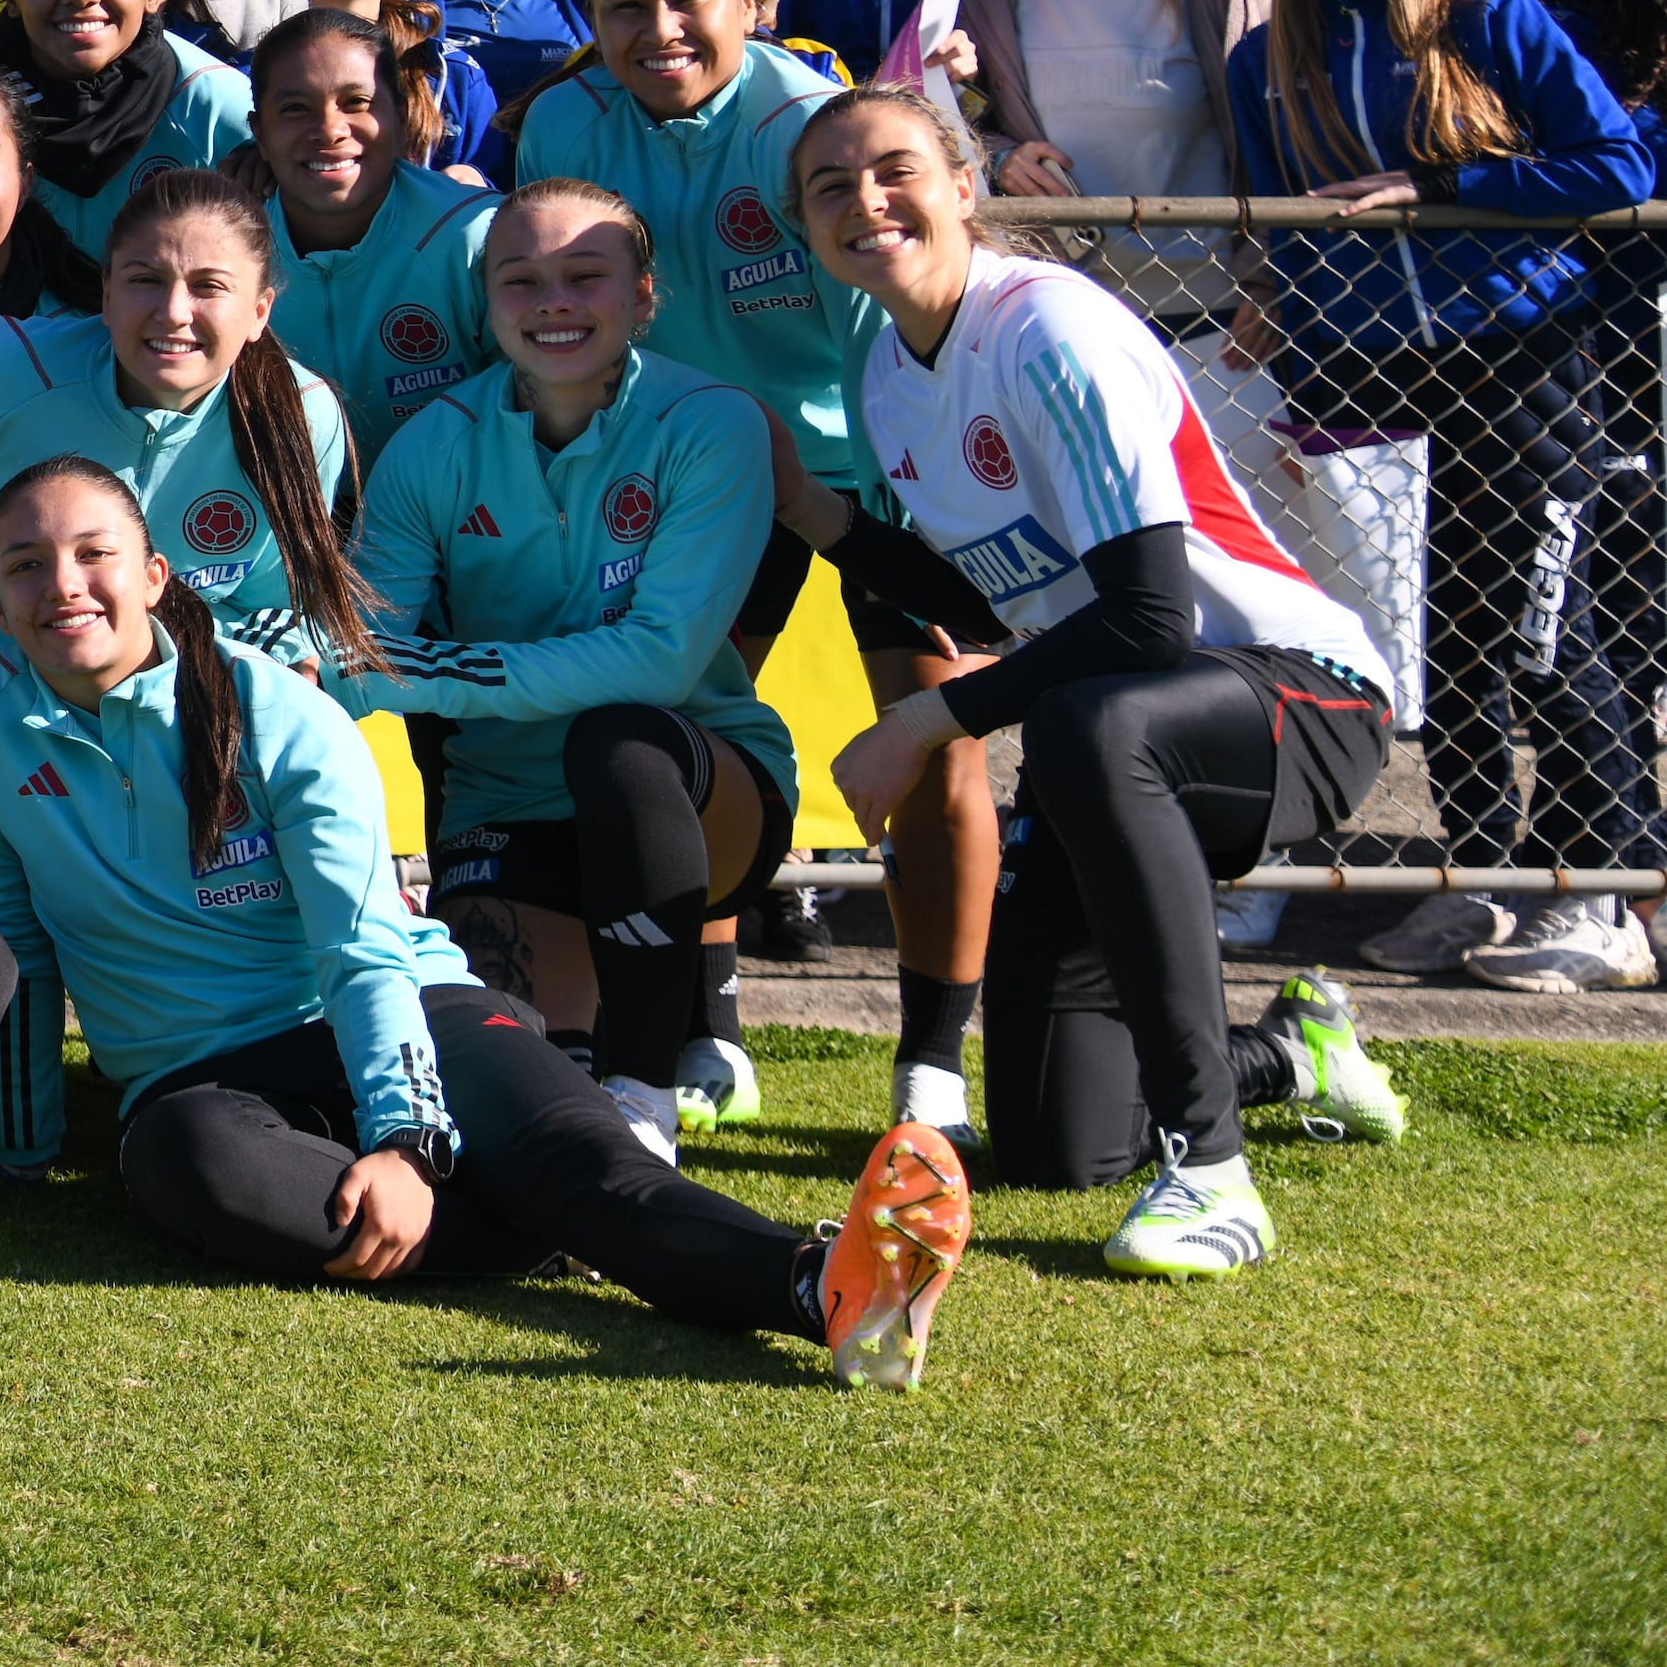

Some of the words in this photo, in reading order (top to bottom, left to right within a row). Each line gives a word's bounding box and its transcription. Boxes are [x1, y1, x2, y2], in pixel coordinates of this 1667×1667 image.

[728, 251, 799, 292] AGUILA
[730, 290, 814, 317] BetPlay
[392, 366, 461, 396] AGUILA
[196, 878, 283, 909] BetPlay
